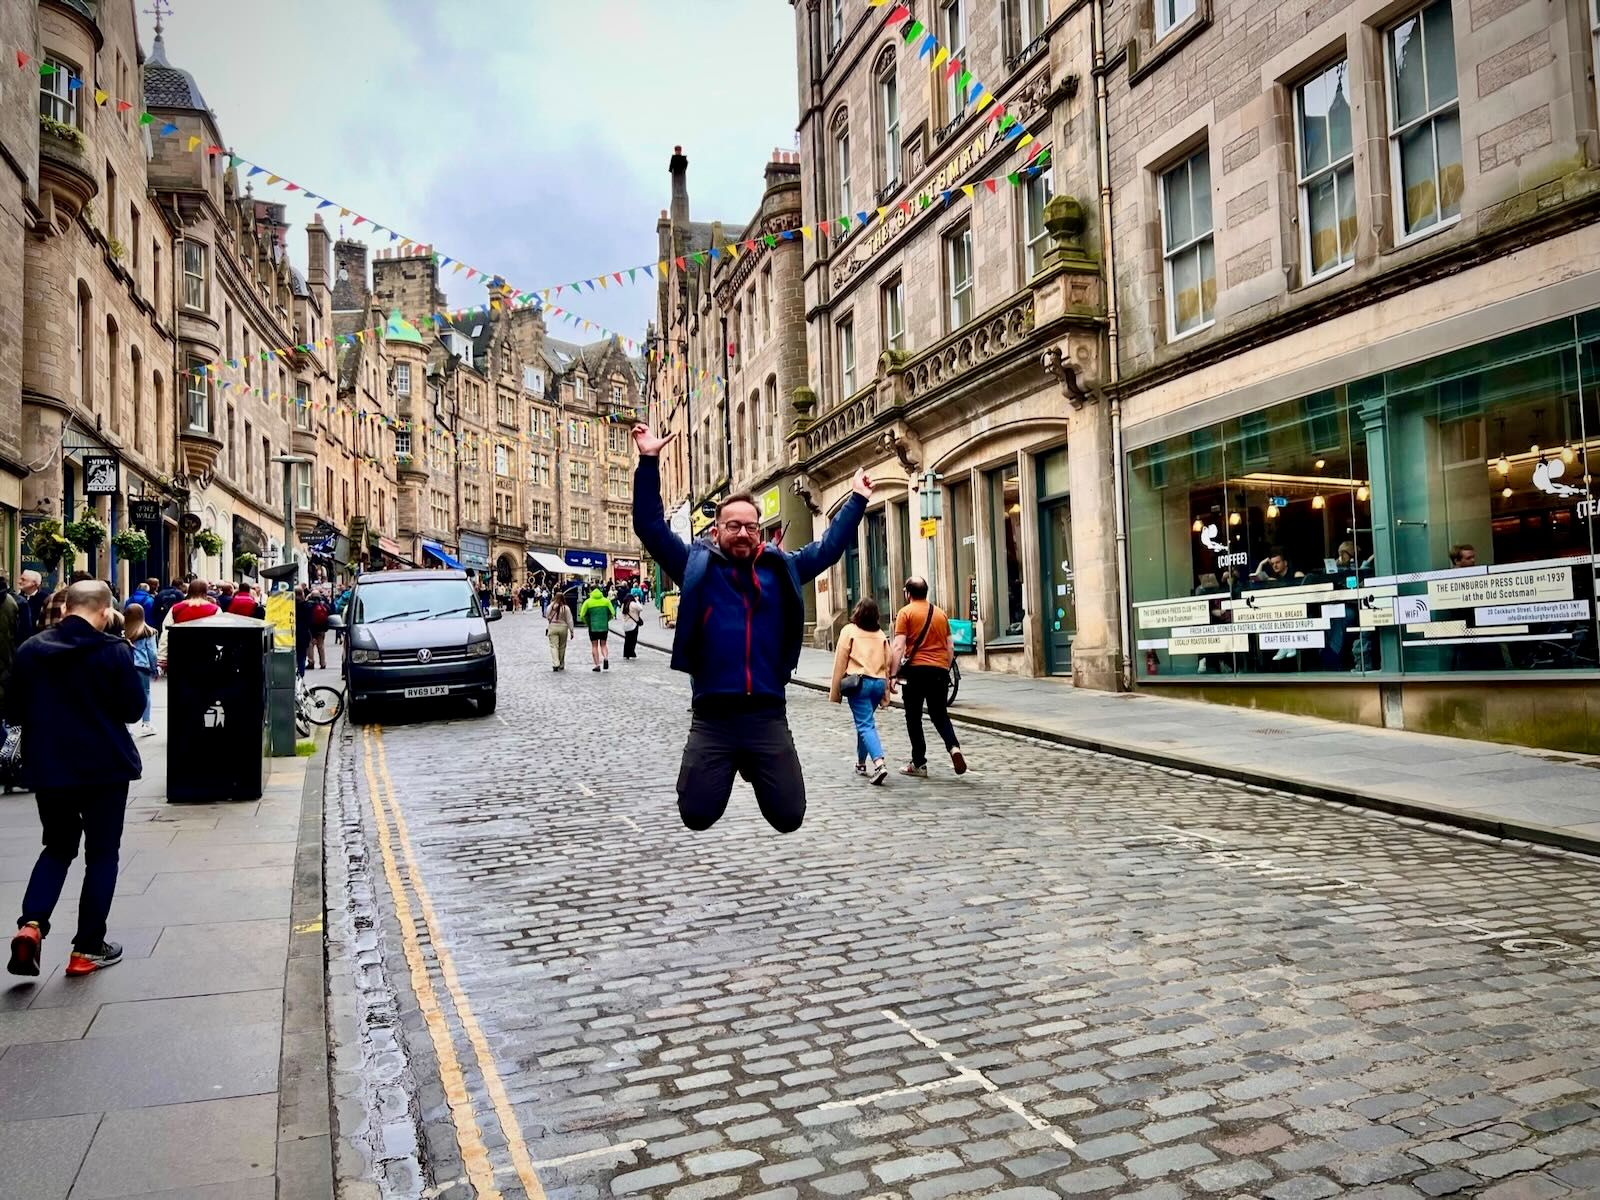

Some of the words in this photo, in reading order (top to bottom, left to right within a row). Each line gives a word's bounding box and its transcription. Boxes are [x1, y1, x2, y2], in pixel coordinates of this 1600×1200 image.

[1437, 584, 1448, 592] THE
[1451, 580, 1488, 592] EDINBURGH
[1490, 578, 1513, 587] PRESS
[1515, 576, 1534, 585] CLUB
[1547, 572, 1565, 582] 1939
[1462, 593, 1471, 601] (at
[1473, 592, 1483, 600] the
[1486, 590, 1497, 599] Old
[1499, 588, 1537, 598] Scotsman)
[1494, 607, 1516, 615] Cockburn
[1533, 604, 1558, 612] Edinburgh
[1274, 621, 1294, 629] BLENDED
[1295, 620, 1314, 628] SYRUPS
[1264, 635, 1279, 643] CRAFT
[1297, 634, 1309, 642] WINE
[430, 687, 445, 695] LPX
